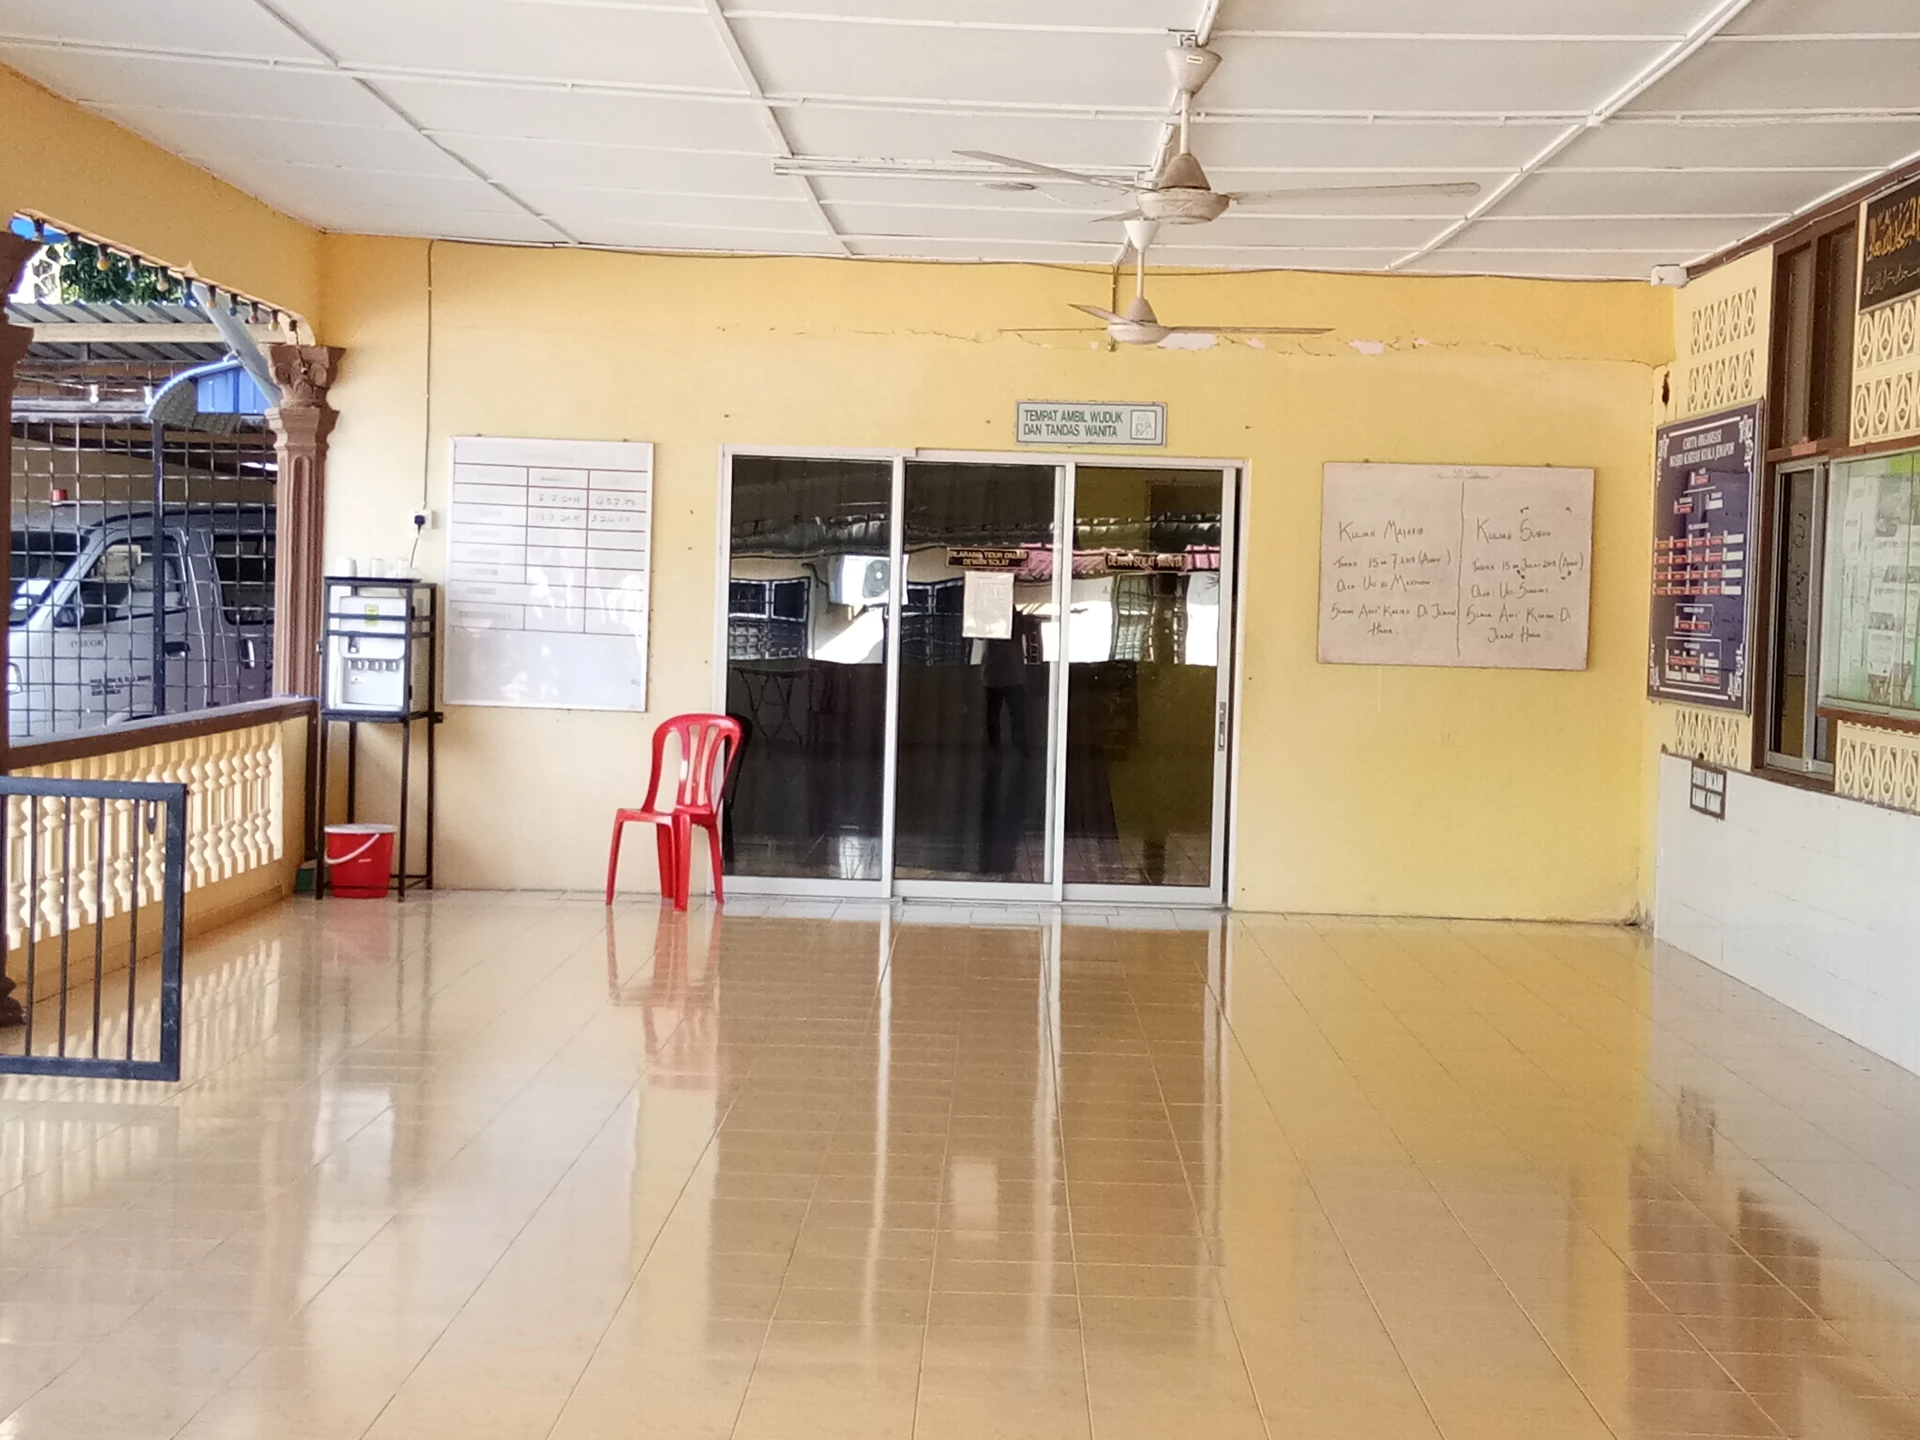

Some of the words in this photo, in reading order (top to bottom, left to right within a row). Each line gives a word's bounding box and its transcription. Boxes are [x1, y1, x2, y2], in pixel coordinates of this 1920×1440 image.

[1023, 409, 1058, 422] TEMPAT
[1061, 410, 1087, 423] AMBIL
[1090, 411, 1124, 424] WUDUK
[1023, 423, 1042, 436] DAN
[1045, 424, 1080, 437] TANDAS
[1085, 425, 1118, 437] WANITA
[949, 551, 984, 559] DILARANG
[1107, 555, 1133, 567] DEWAN
[1133, 556, 1155, 567] SOLAT
